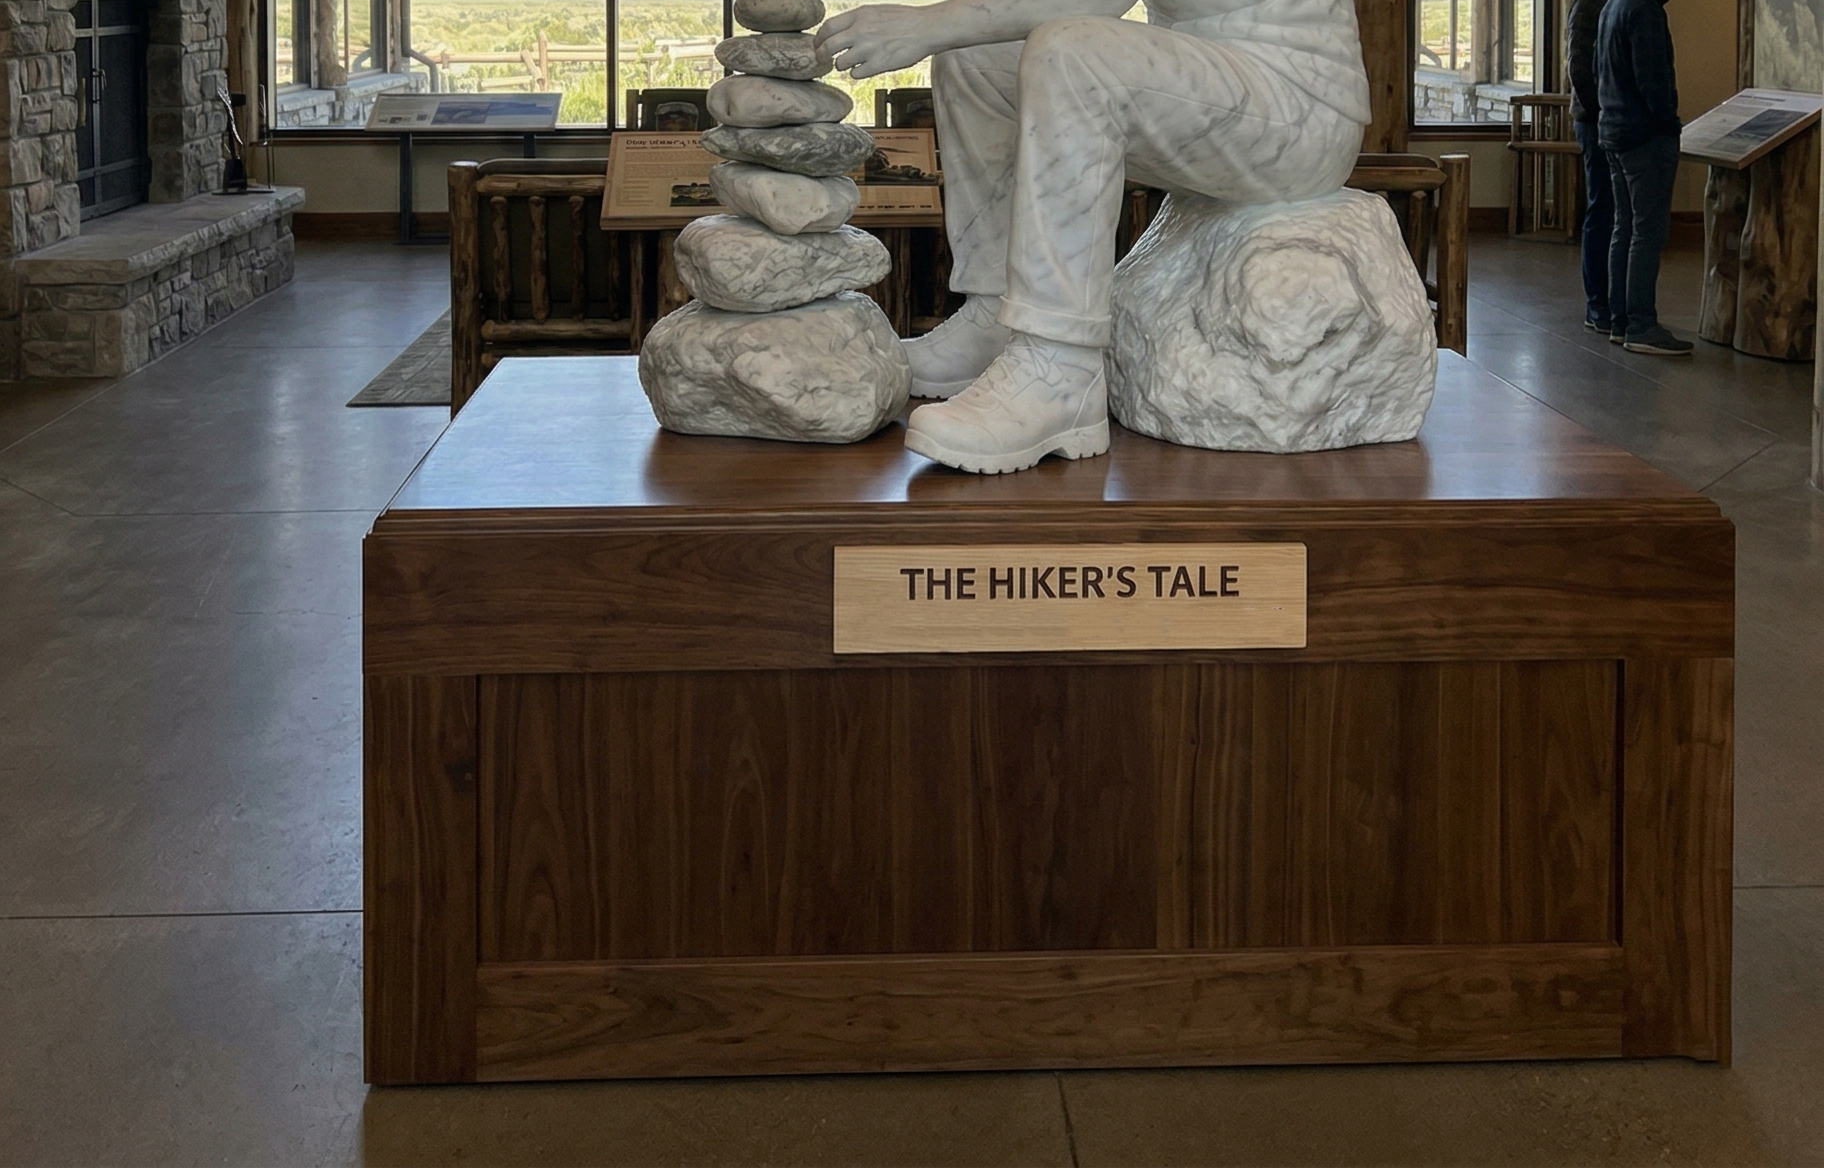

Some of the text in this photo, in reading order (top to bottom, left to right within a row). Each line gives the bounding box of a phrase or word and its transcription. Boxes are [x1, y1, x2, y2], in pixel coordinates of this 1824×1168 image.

[900, 565, 1240, 600] THE HIKER'S TALE
